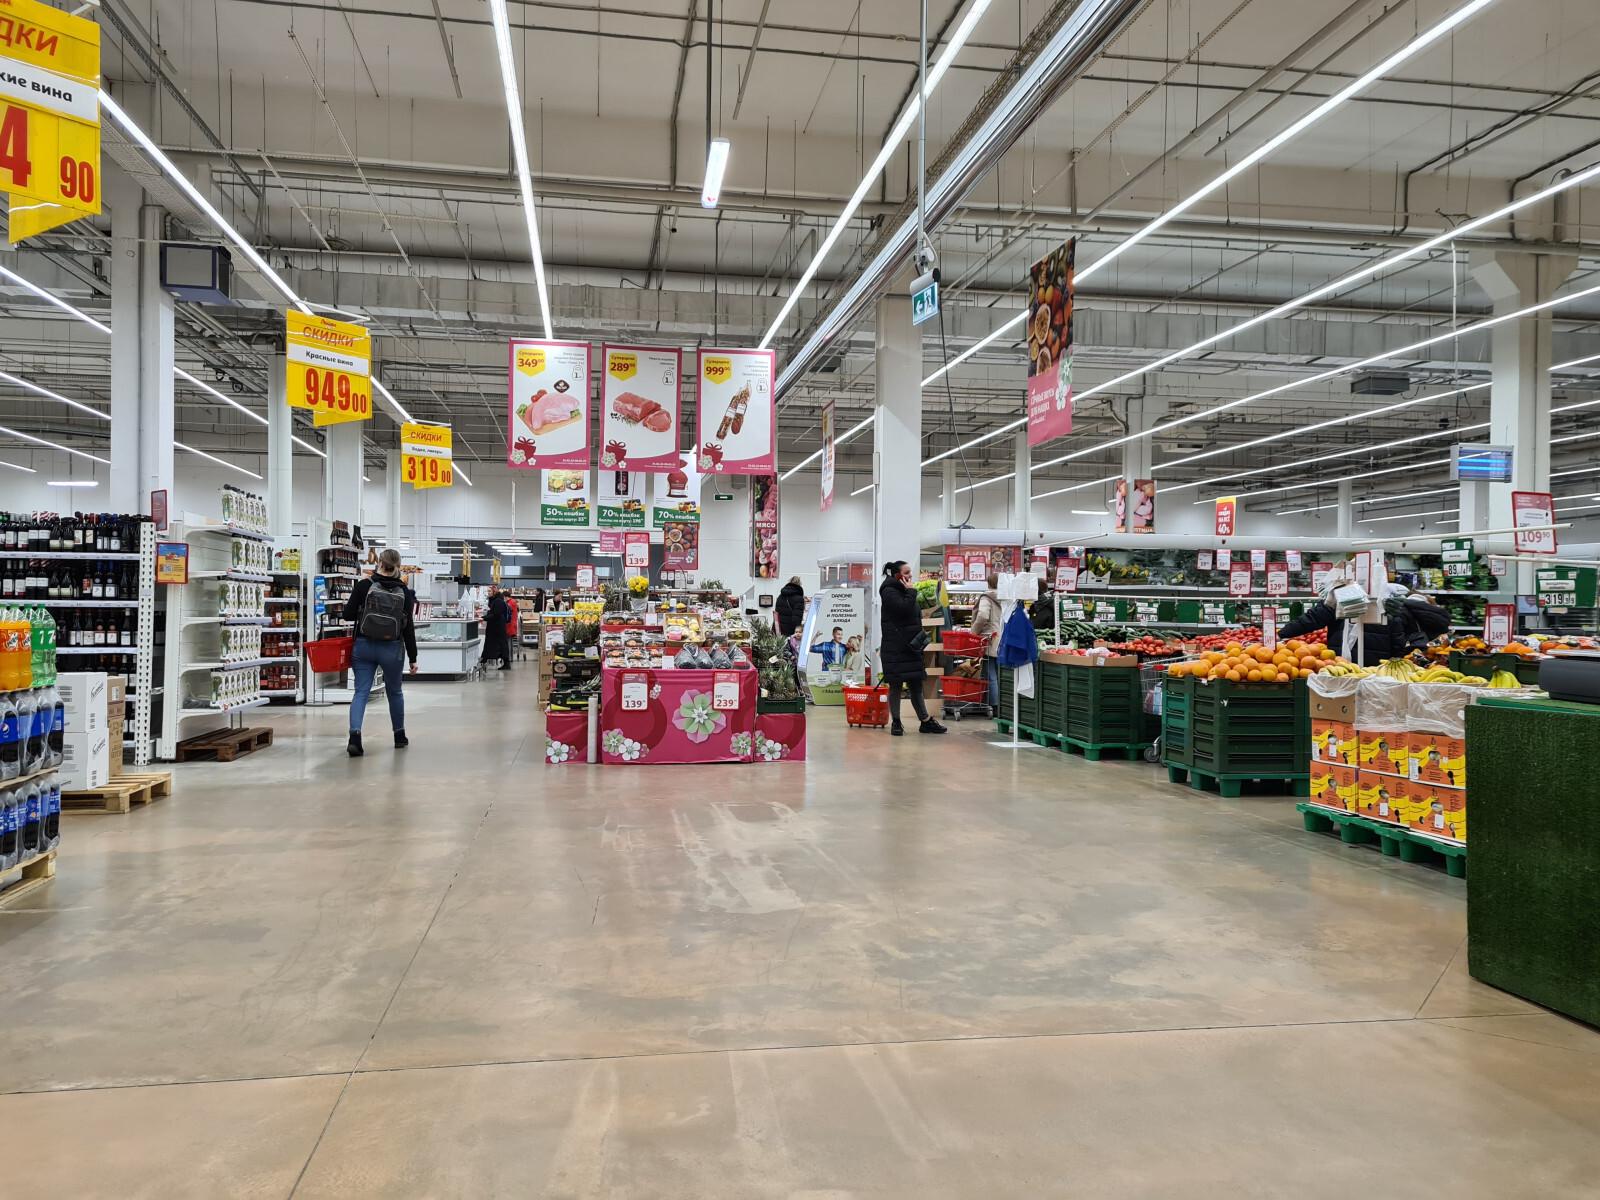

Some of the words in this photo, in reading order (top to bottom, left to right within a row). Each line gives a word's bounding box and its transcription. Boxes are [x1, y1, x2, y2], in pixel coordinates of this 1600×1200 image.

[31, 81, 72, 102] вина
[0, 105, 32, 188] 4
[60, 156, 94, 203] 90
[303, 326, 354, 347] СКИДКИ
[306, 351, 336, 363] Красные
[518, 358, 538, 368] 349
[610, 362, 630, 372] 289
[706, 366, 724, 375] 999
[306, 368, 350, 411] 949
[352, 393, 367, 414] 00
[411, 432, 442, 442] СКИДКИ
[408, 457, 438, 482] 319
[442, 470, 451, 483] 00
[546, 508, 562, 516] 50%
[602, 509, 619, 517] 70%
[658, 511, 674, 519] 70%
[1521, 531, 1542, 543] 109
[1448, 565, 1457, 575] 89
[1234, 583, 1242, 591] 49
[1270, 583, 1281, 591] 129
[1545, 594, 1563, 605] 319
[625, 700, 642, 708] 139
[716, 699, 734, 707] 239
